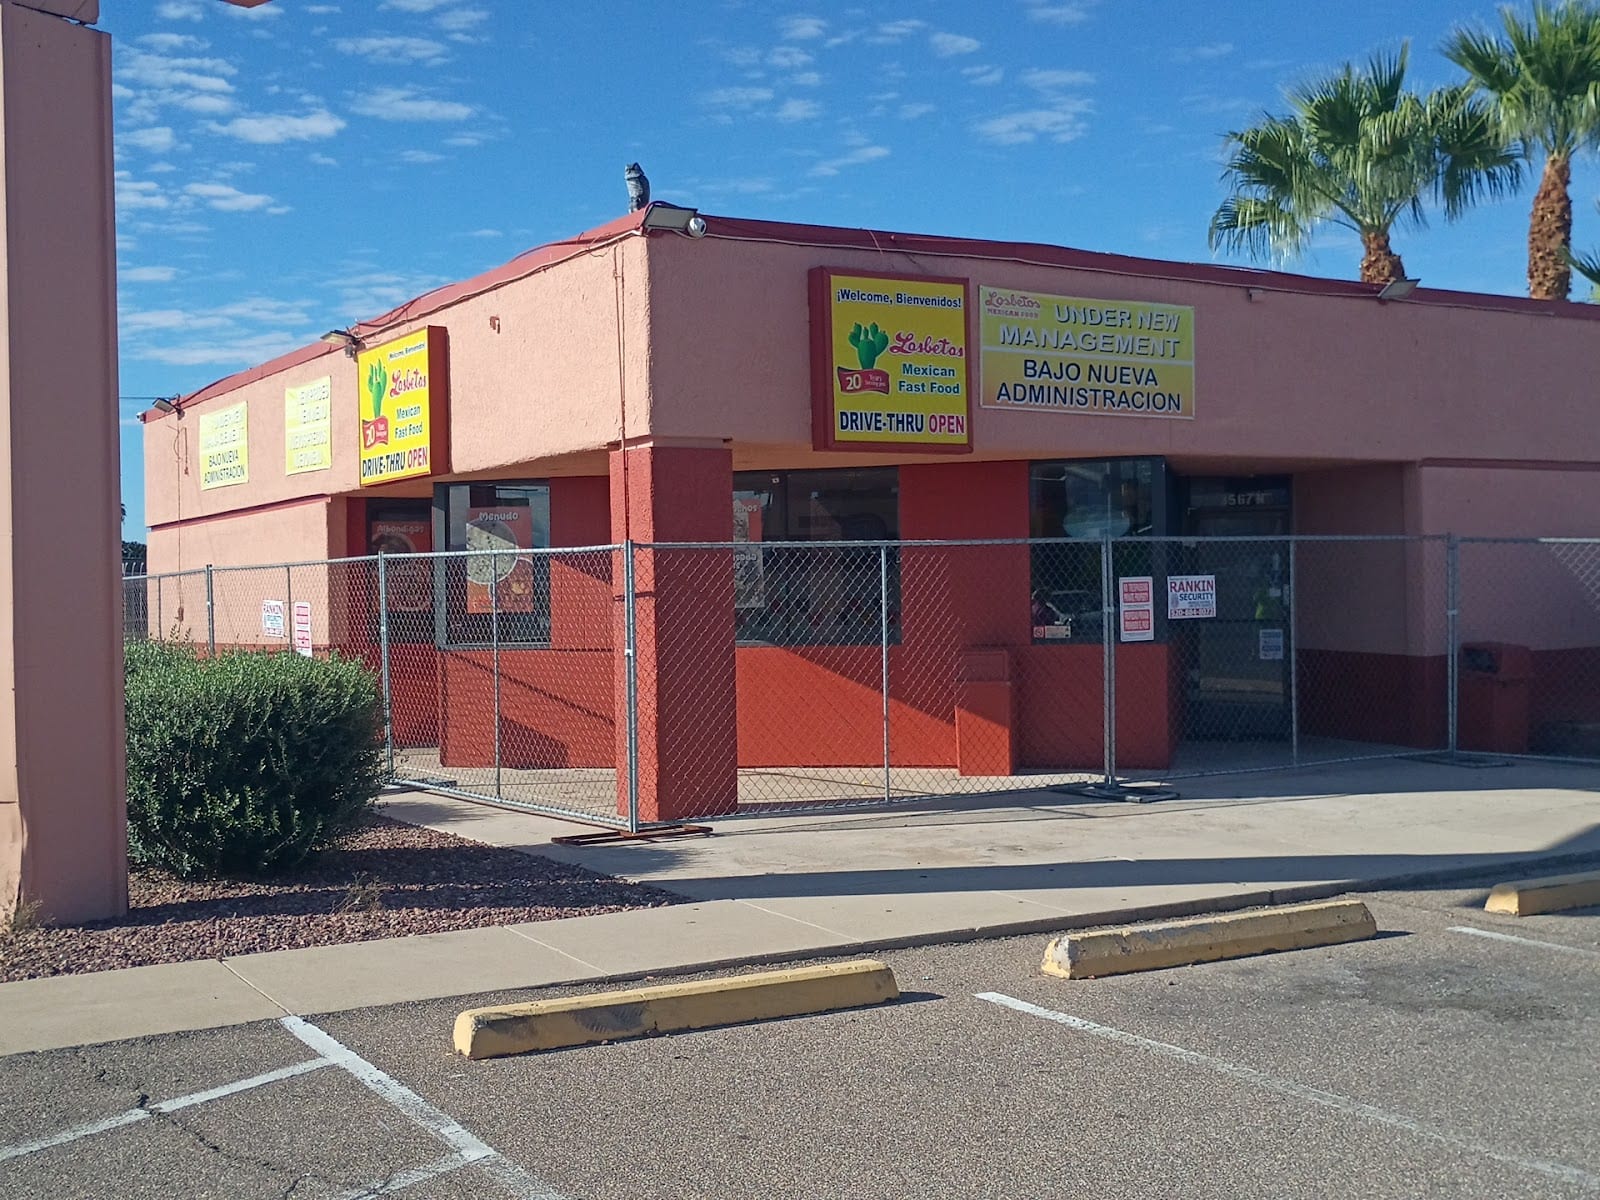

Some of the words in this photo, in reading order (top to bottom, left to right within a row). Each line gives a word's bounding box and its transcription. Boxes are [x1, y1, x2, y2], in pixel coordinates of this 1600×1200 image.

[837, 289, 893, 305] ¡Welcome,
[896, 293, 961, 308] Bienvenidos!
[985, 291, 1040, 308] Losbetos
[1055, 304, 1132, 329] UNDER
[1138, 311, 1180, 332] NEW
[1001, 325, 1181, 358] MANAGEMENT
[902, 363, 955, 377] Mexican
[1024, 359, 1081, 381] BAJO
[1087, 363, 1158, 386] NUEVA
[846, 373, 861, 390] 20
[898, 380, 926, 393] Fast
[930, 382, 960, 394] Food
[996, 382, 1181, 411] ADMINISTRACION
[396, 406, 420, 419] Mexican
[395, 427, 408, 439] Fast
[409, 421, 423, 435] Food
[840, 411, 924, 433] DRIVE-THRU
[928, 413, 965, 434] OPEN
[362, 451, 406, 477] DRIVE-THRU
[407, 446, 428, 469] OPEN
[479, 511, 519, 522] Menudo
[1169, 579, 1214, 593] RANKIN
[1179, 592, 1214, 602] SECURITY
